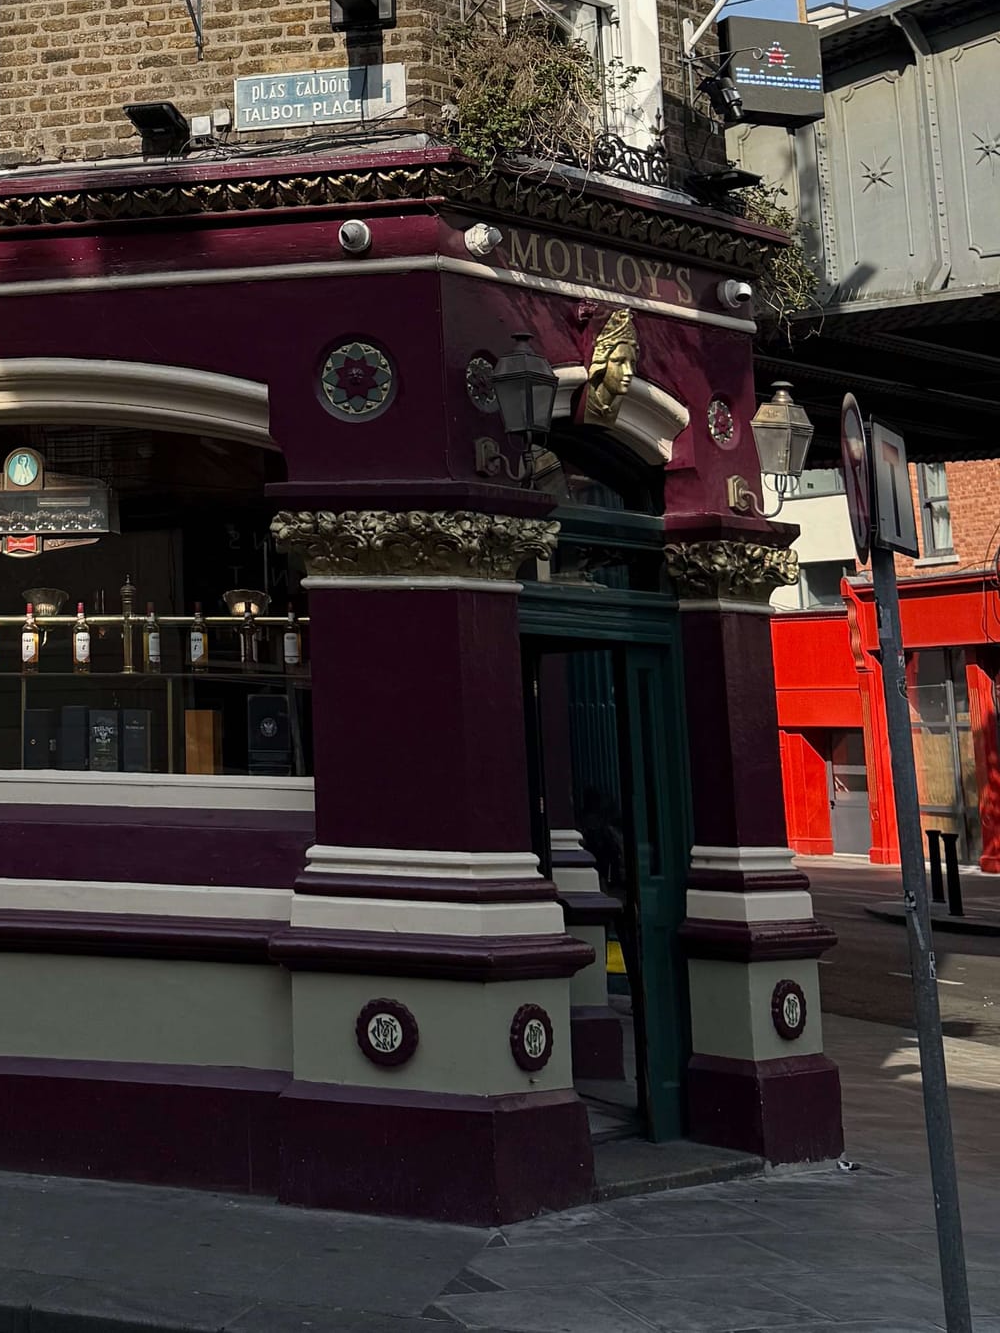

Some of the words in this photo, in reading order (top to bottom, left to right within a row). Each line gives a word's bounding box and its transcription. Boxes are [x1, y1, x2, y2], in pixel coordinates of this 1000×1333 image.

[242, 104, 305, 123] TALBOT
[312, 99, 363, 117] PLACE
[508, 228, 694, 304] MOLLOY'S
